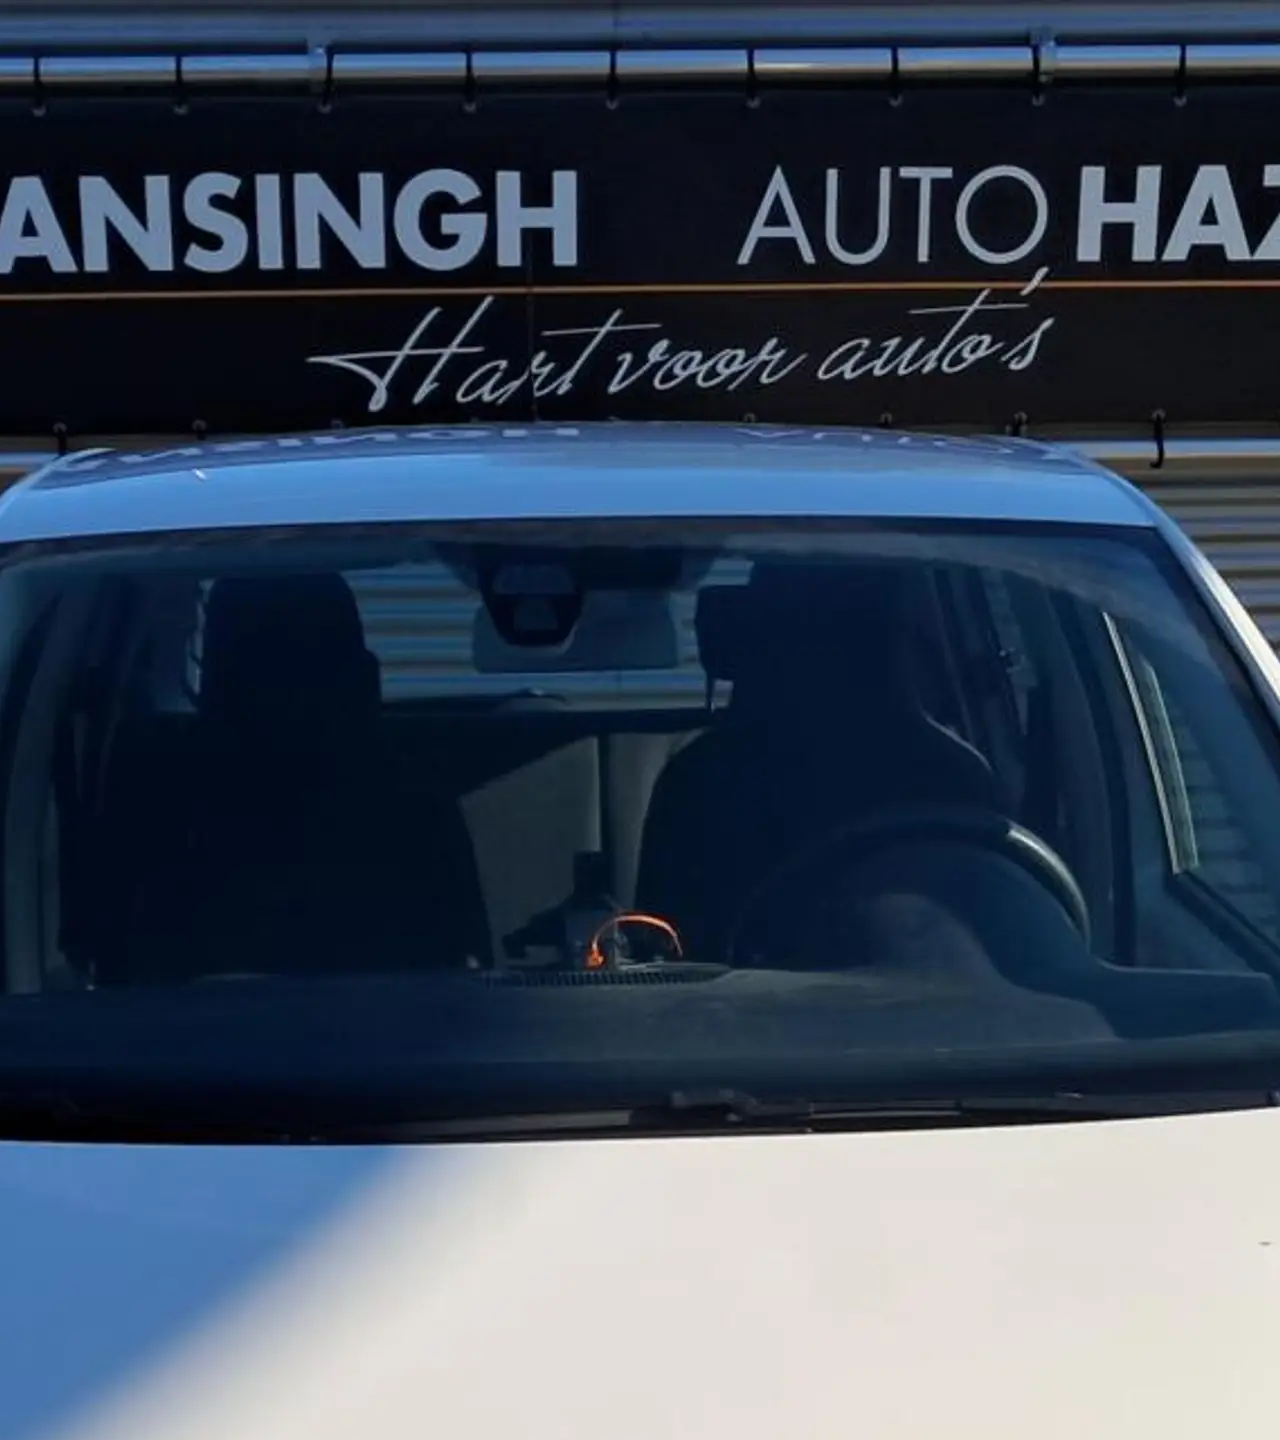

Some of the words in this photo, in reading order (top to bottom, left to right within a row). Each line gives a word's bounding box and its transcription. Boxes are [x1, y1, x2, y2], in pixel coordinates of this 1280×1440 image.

[737, 164, 1048, 264] AUTO
[307, 296, 661, 411] Hart
[606, 335, 805, 393] voor
[817, 267, 1054, 380] auto's
